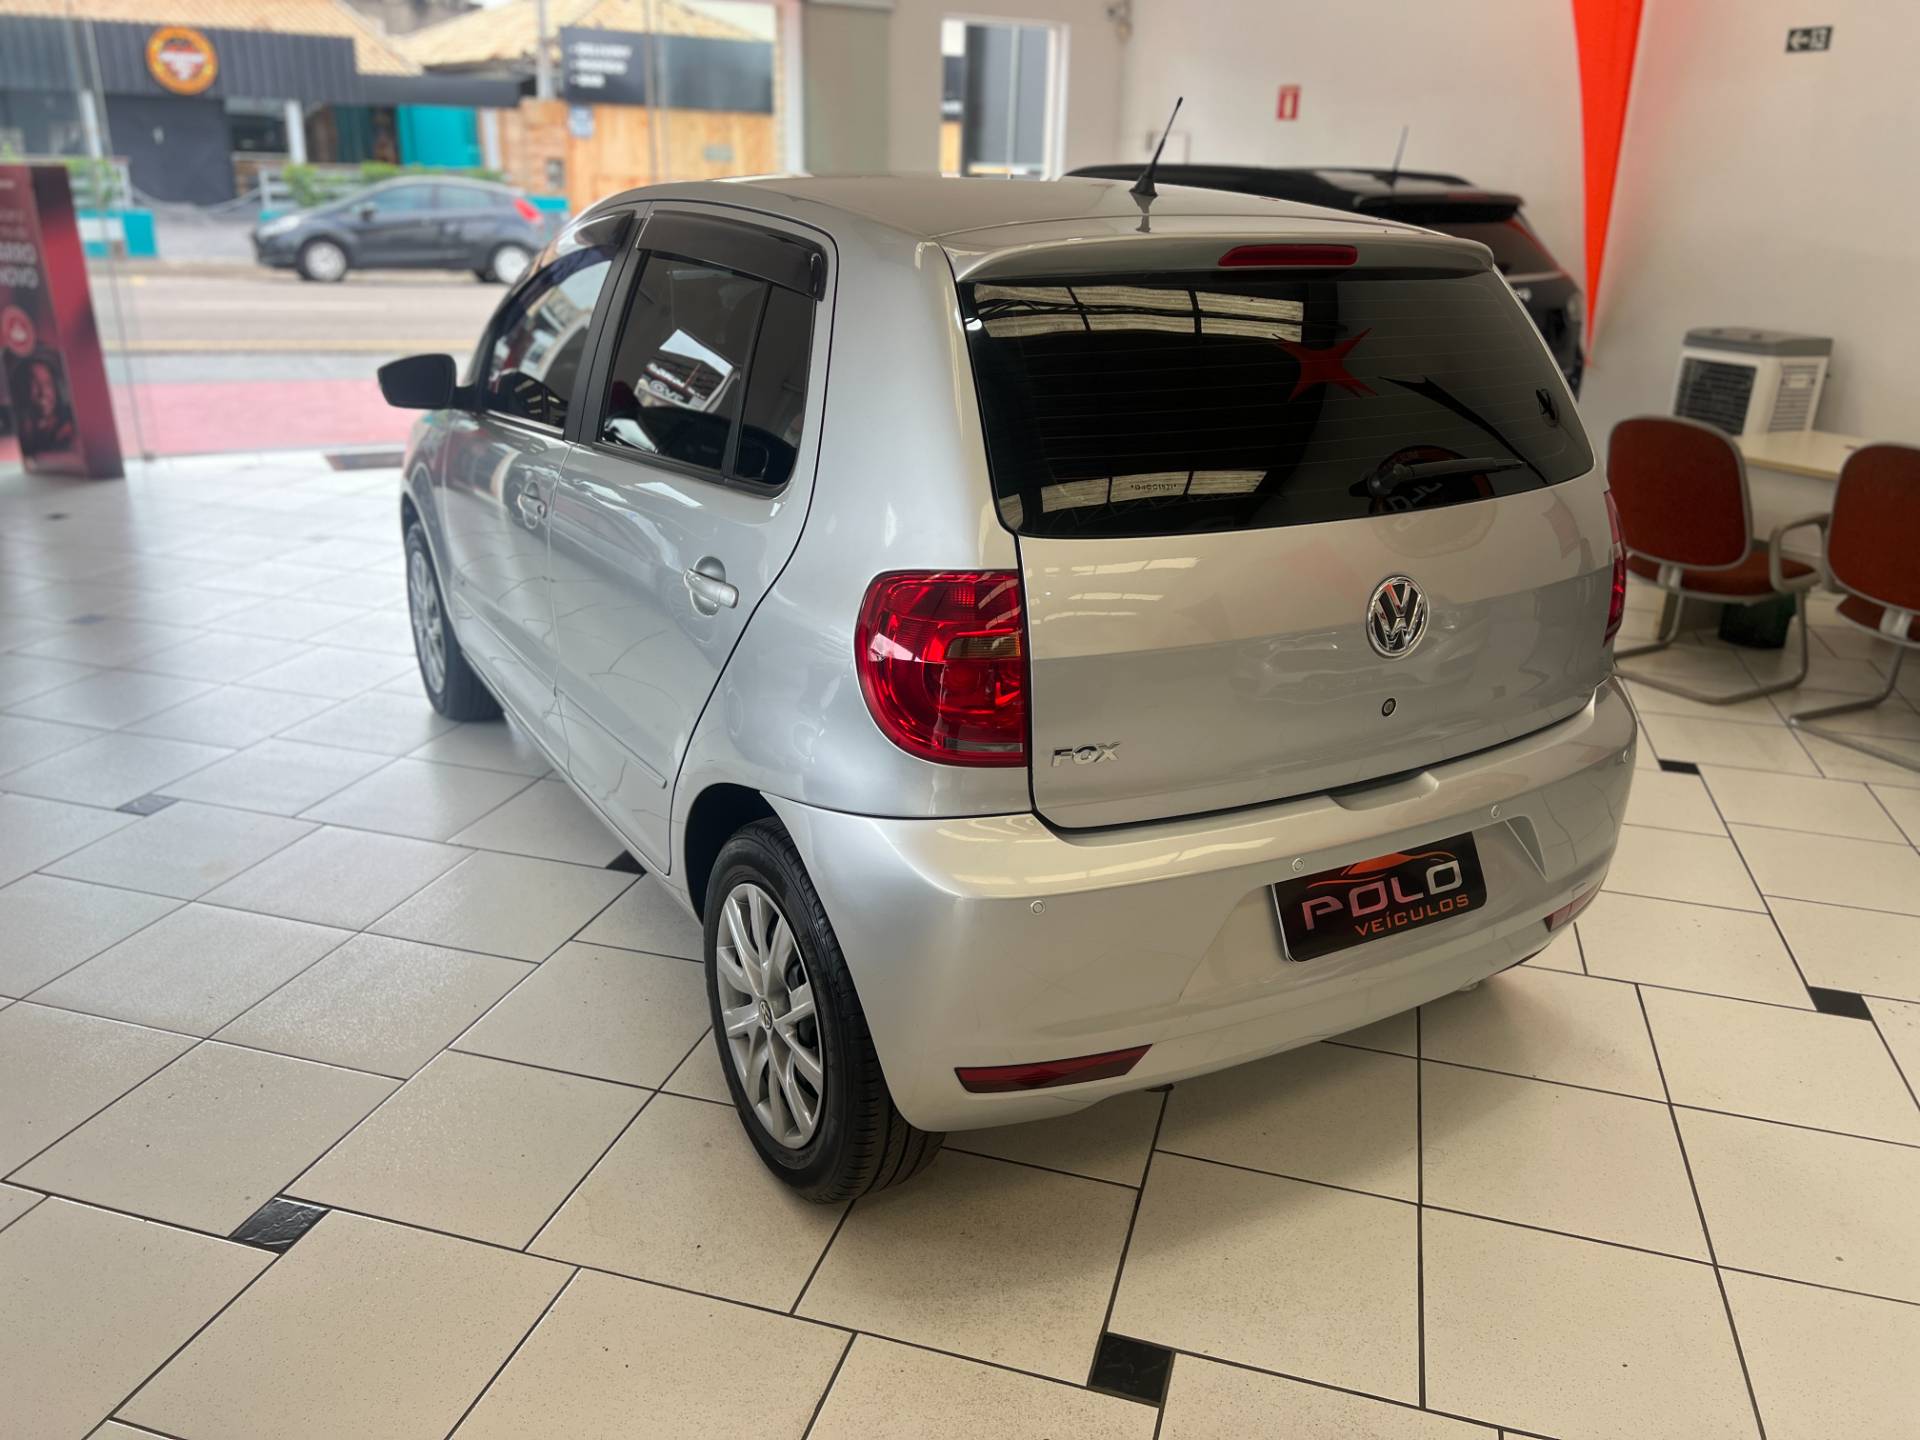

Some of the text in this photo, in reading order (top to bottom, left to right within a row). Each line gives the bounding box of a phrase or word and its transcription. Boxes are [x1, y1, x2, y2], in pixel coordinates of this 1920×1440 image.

[1051, 742, 1121, 768] FOX
[1302, 860, 1463, 931] POLO
[1354, 894, 1469, 937] VEÍCULOS
